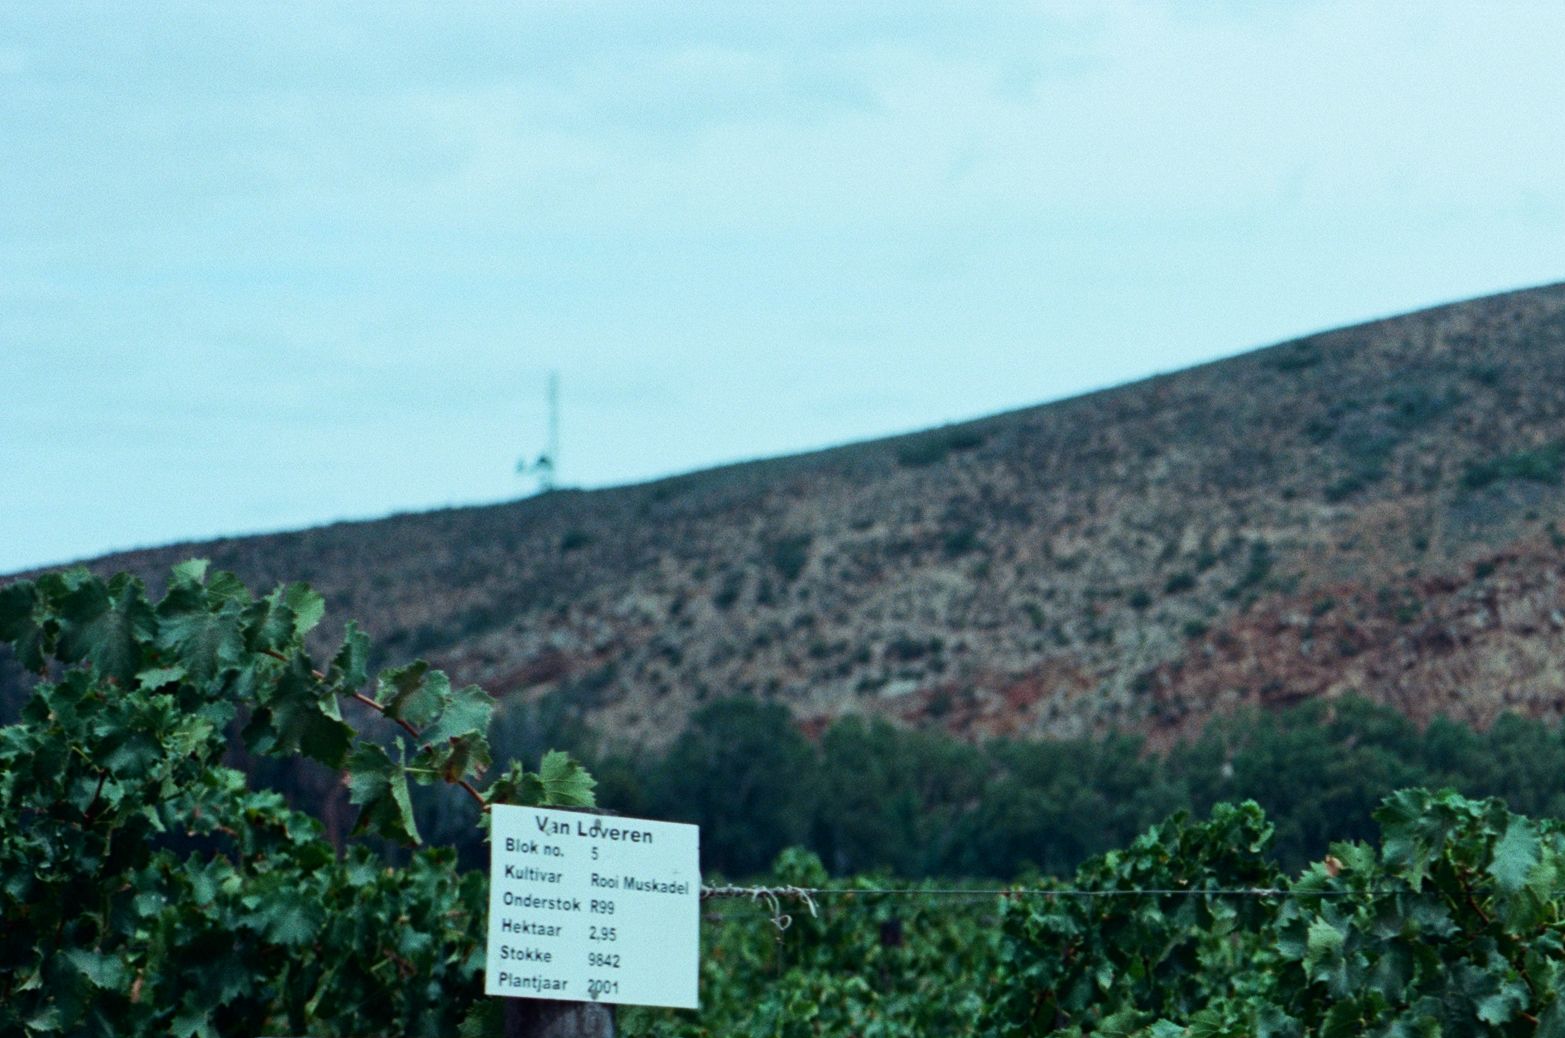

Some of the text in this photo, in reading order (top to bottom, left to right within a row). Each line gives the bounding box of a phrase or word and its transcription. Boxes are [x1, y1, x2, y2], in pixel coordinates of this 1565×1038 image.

[535, 815, 653, 844] Van Loveren
[505, 837, 599, 861] Blok no. 5
[504, 865, 689, 895] Kultivar Rooi Muskadel
[503, 892, 615, 915] Onderstok R99
[502, 918, 617, 942] Hektaar 2,95
[500, 945, 621, 968] Stokke 9842
[499, 972, 620, 995] Plantjaar 2001
